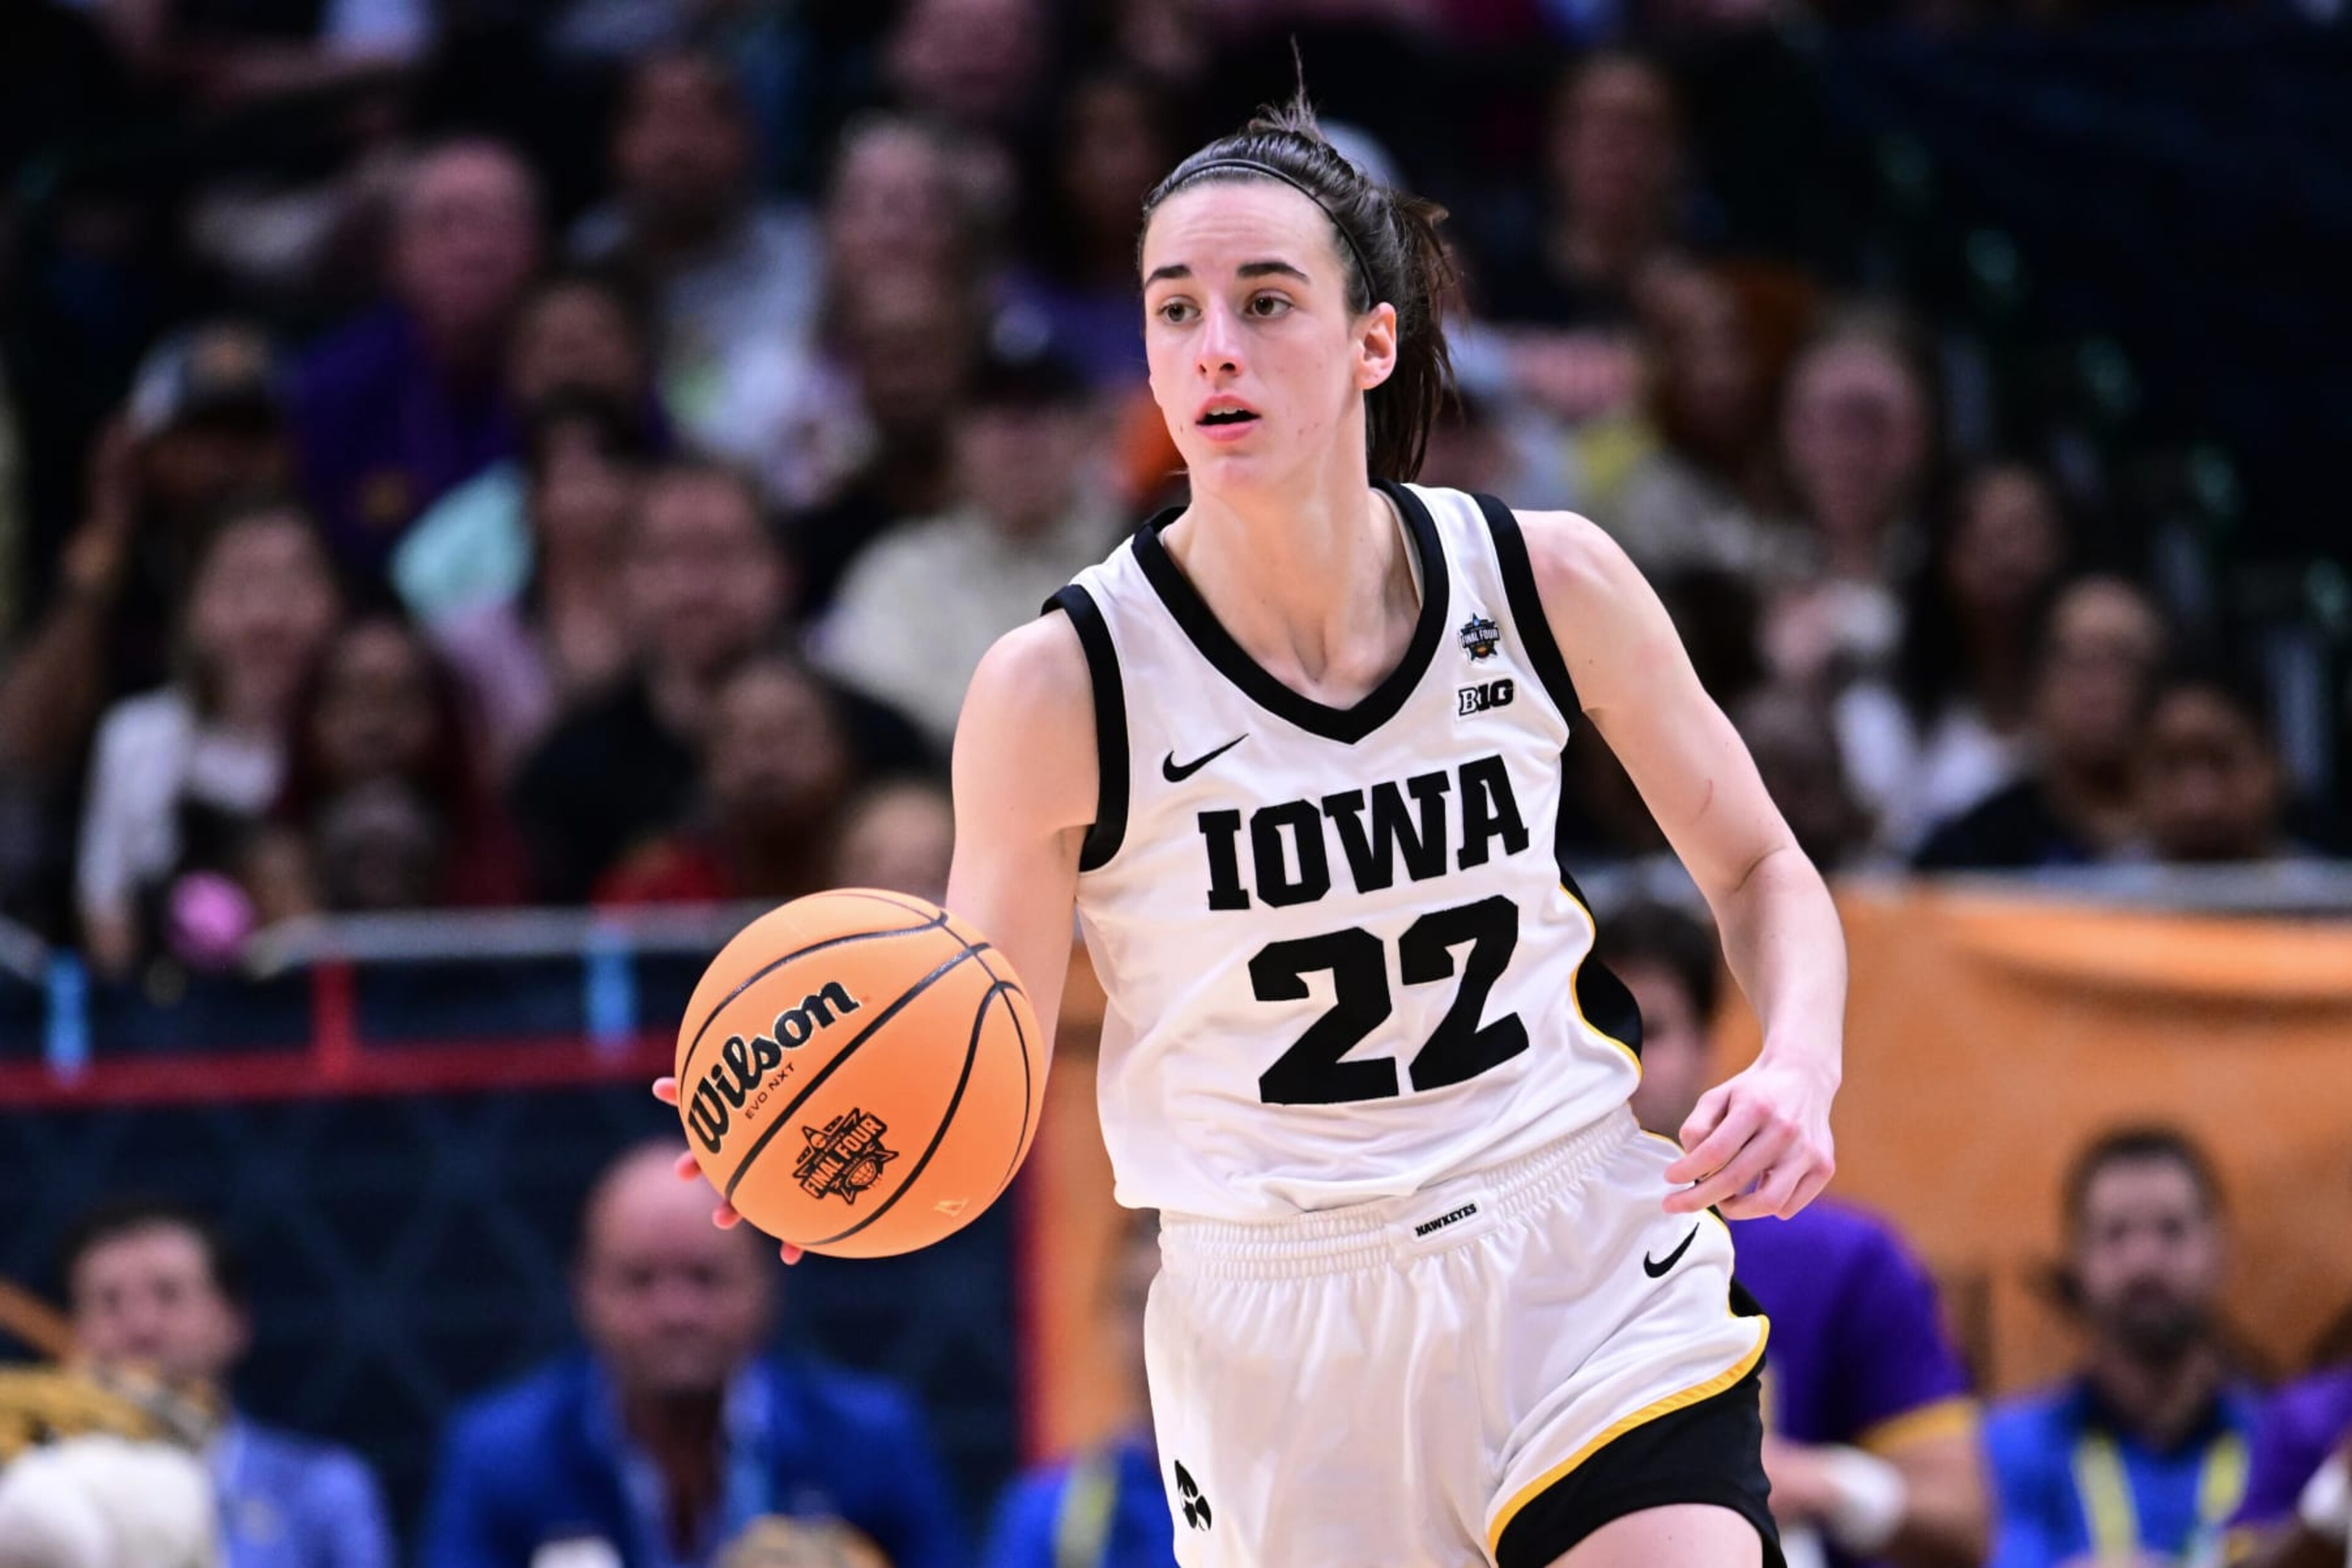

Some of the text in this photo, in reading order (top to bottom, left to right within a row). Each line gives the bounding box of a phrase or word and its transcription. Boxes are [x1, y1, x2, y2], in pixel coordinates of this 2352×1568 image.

[1479, 628, 1498, 640] FOUR
[1197, 755, 1529, 911] IOWA
[1248, 895, 1529, 1104] 22
[688, 981, 860, 1154] Wilson
[745, 1061, 794, 1120] EVO NXT
[802, 1156, 845, 1198] FINAL
[834, 1117, 883, 1161] FOUR
[1415, 1203, 1477, 1237] HAWKEYES
